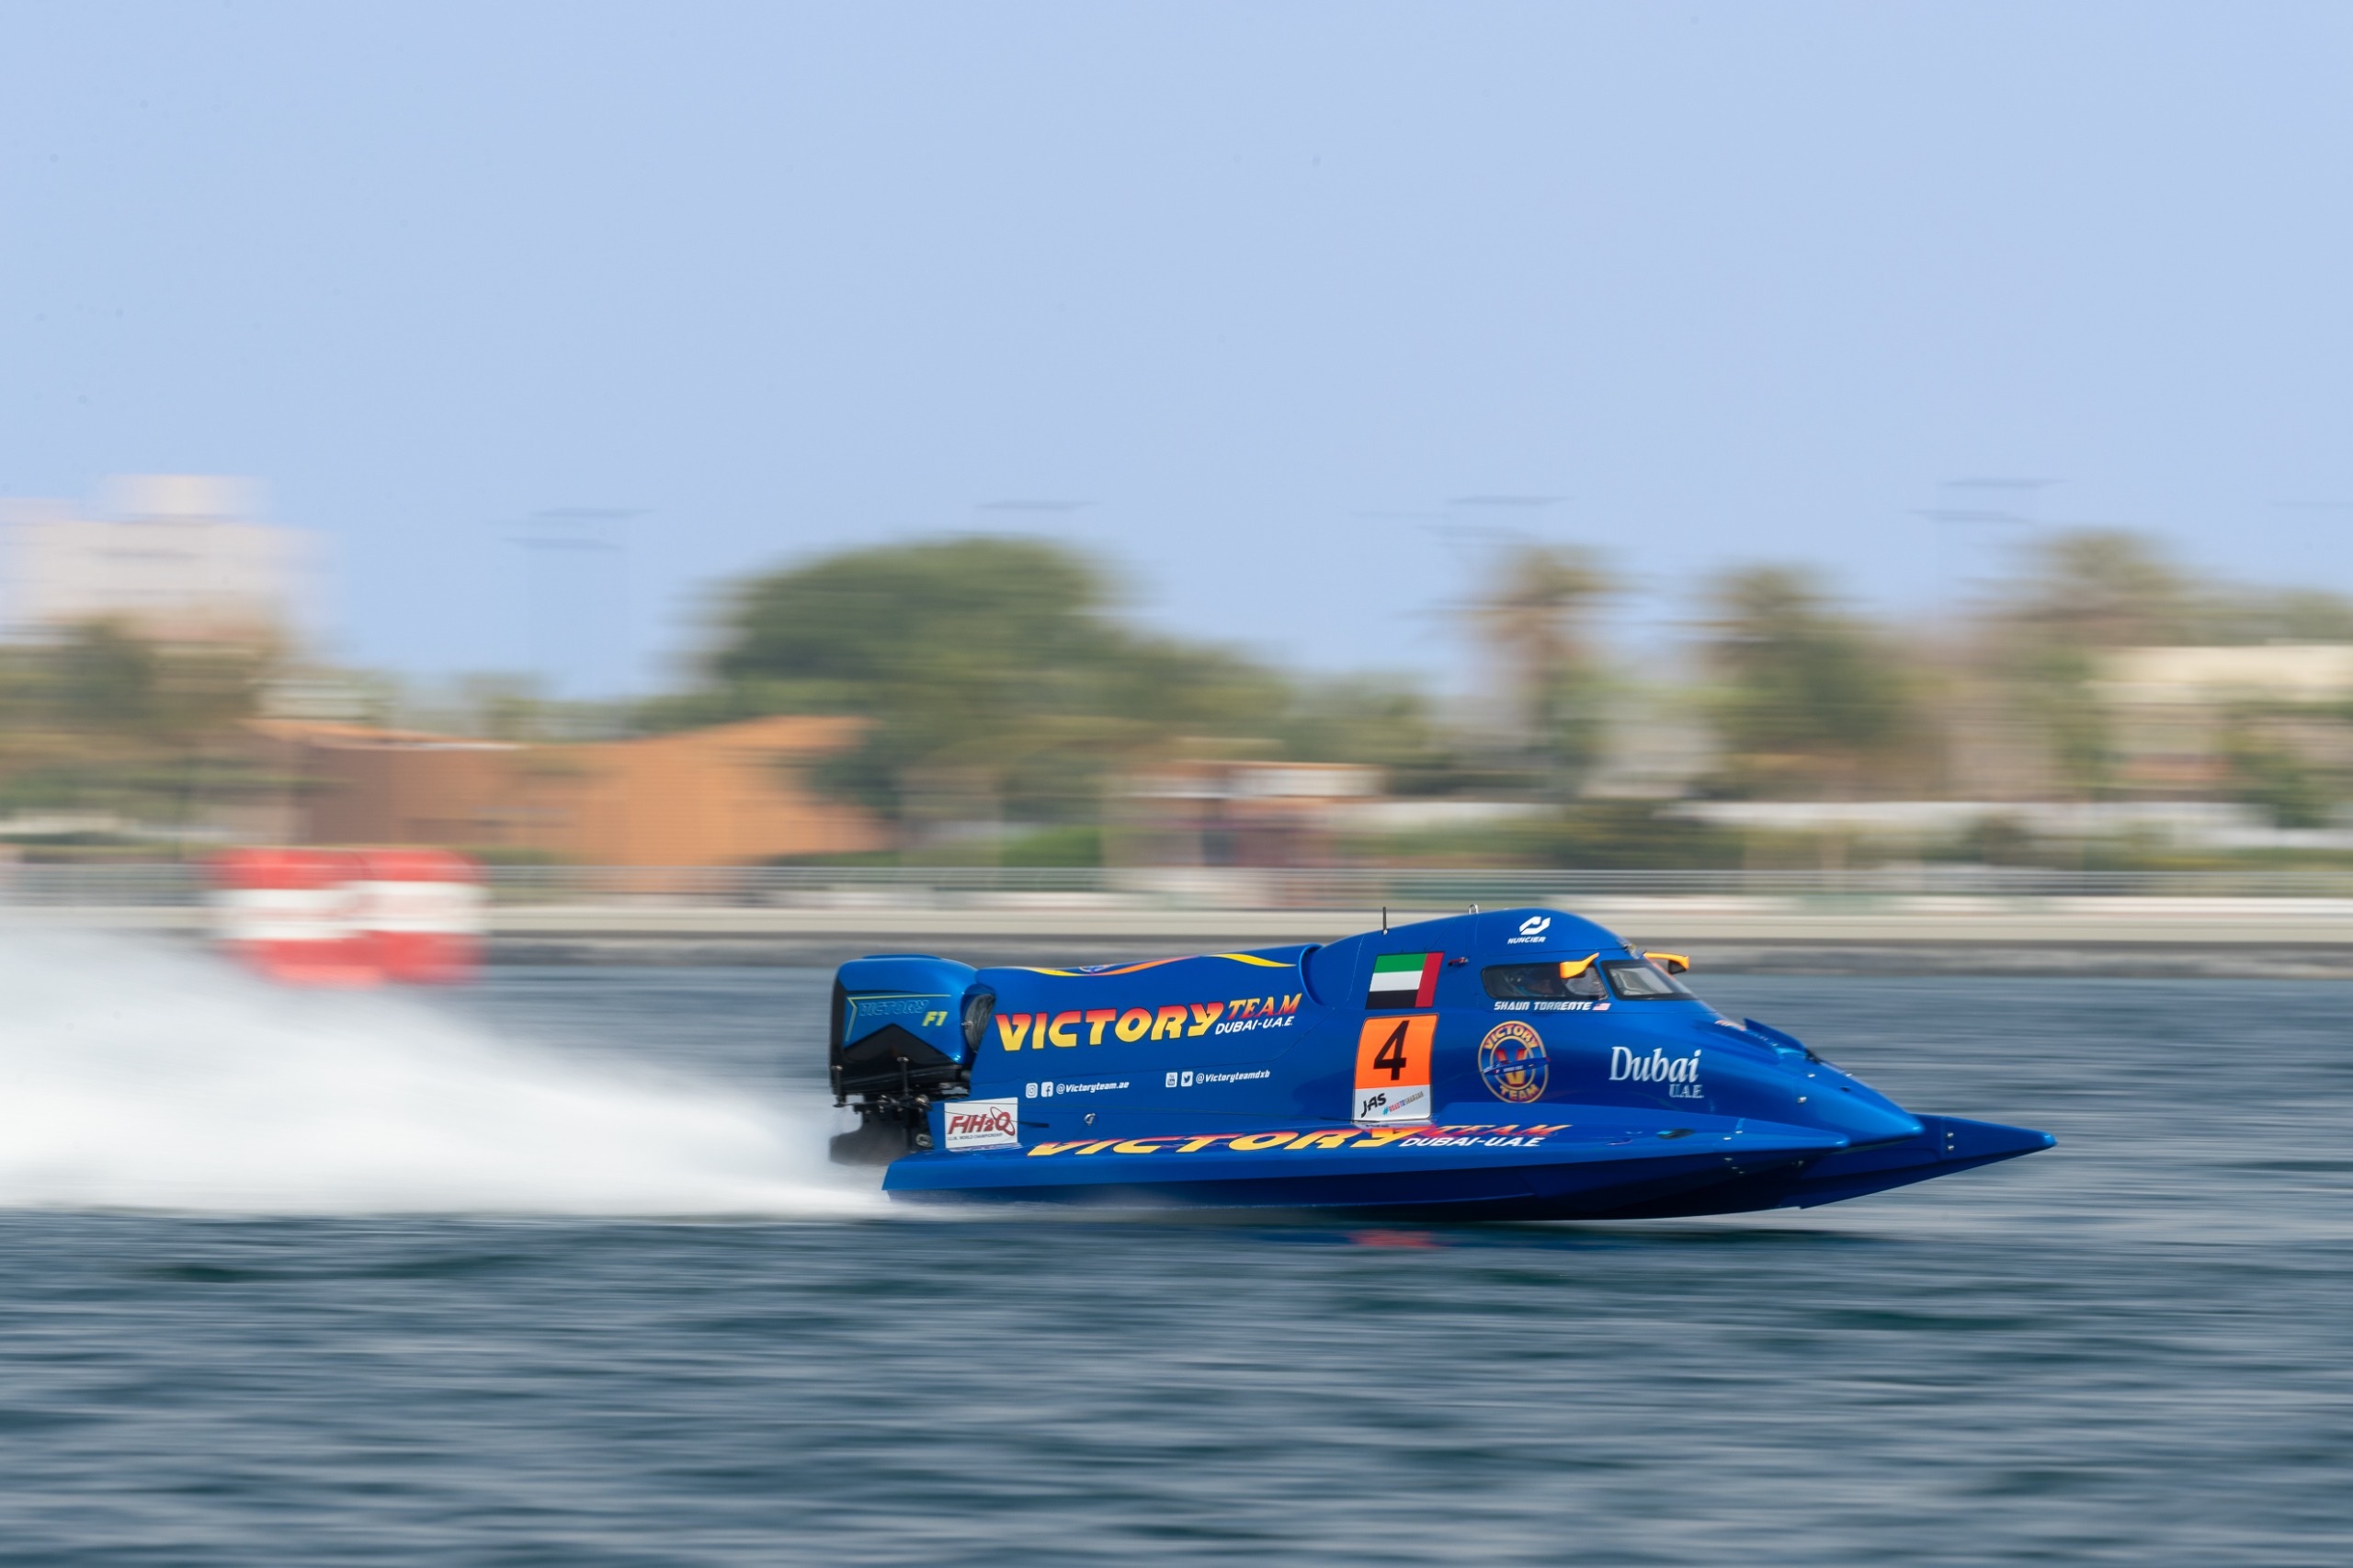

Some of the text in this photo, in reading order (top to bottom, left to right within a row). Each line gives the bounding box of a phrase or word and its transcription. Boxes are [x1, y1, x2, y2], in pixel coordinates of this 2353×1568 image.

[1507, 937, 1547, 945] NUNCIER
[858, 999, 930, 1017] VICTORY
[1226, 993, 1302, 1021] TEAM
[1494, 1001, 1594, 1011] SHAUN TORRENTE
[921, 1011, 949, 1027] F1
[995, 1001, 1224, 1052] VICTORY
[1483, 1023, 1541, 1050] VICTORY
[1372, 1019, 1411, 1082] 4
[1608, 1045, 1702, 1084] Dubai
[1195, 1069, 1271, 1085] @Victoryteamdxb
[1055, 1081, 1131, 1094] @Victoryteam.ae
[1499, 1083, 1541, 1102] TEAM
[1360, 1092, 1387, 1119] JAS
[1027, 1124, 1434, 1156] VICTORY
[1430, 1124, 1573, 1138] TEAM
